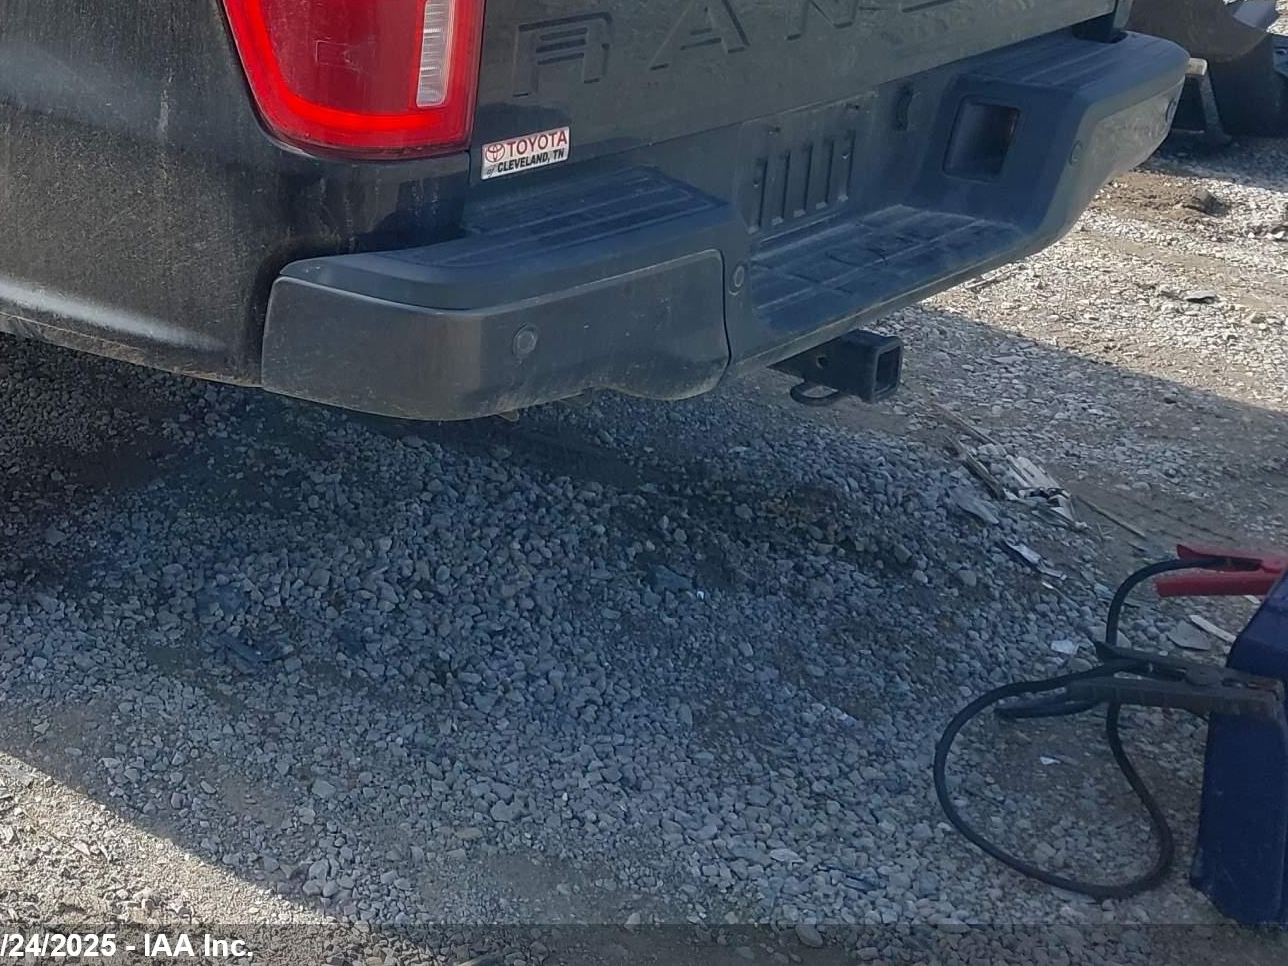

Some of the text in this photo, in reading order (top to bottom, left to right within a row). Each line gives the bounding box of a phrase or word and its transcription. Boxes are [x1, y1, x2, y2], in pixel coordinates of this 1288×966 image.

[506, 130, 568, 158] TOYOTA
[497, 151, 551, 173] CLEVELAND,
[553, 148, 565, 161] TN
